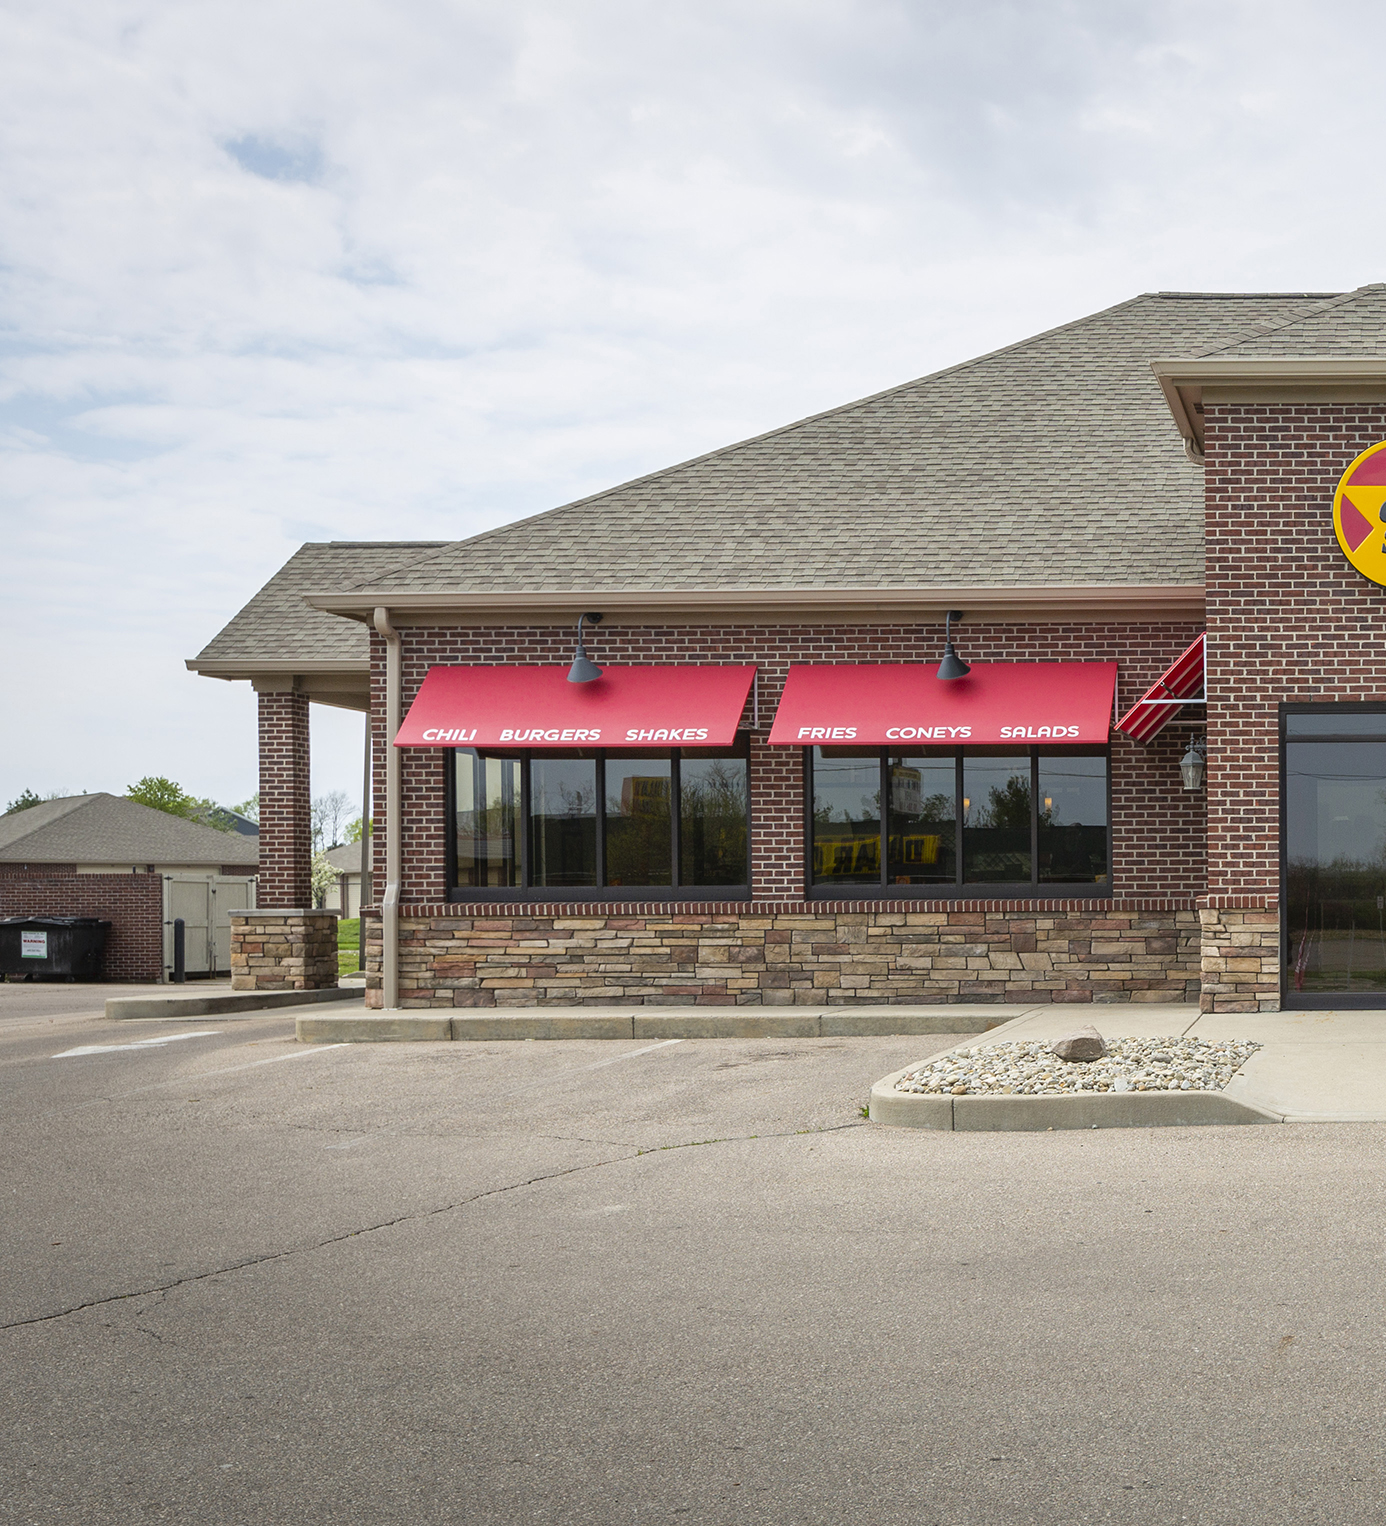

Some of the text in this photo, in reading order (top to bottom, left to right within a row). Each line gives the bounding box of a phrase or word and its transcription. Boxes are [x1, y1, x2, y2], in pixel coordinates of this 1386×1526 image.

[422, 728, 709, 741] CHILI BURGERS SHAKES
[797, 725, 1080, 739] FRIES CONEYS SALADS
